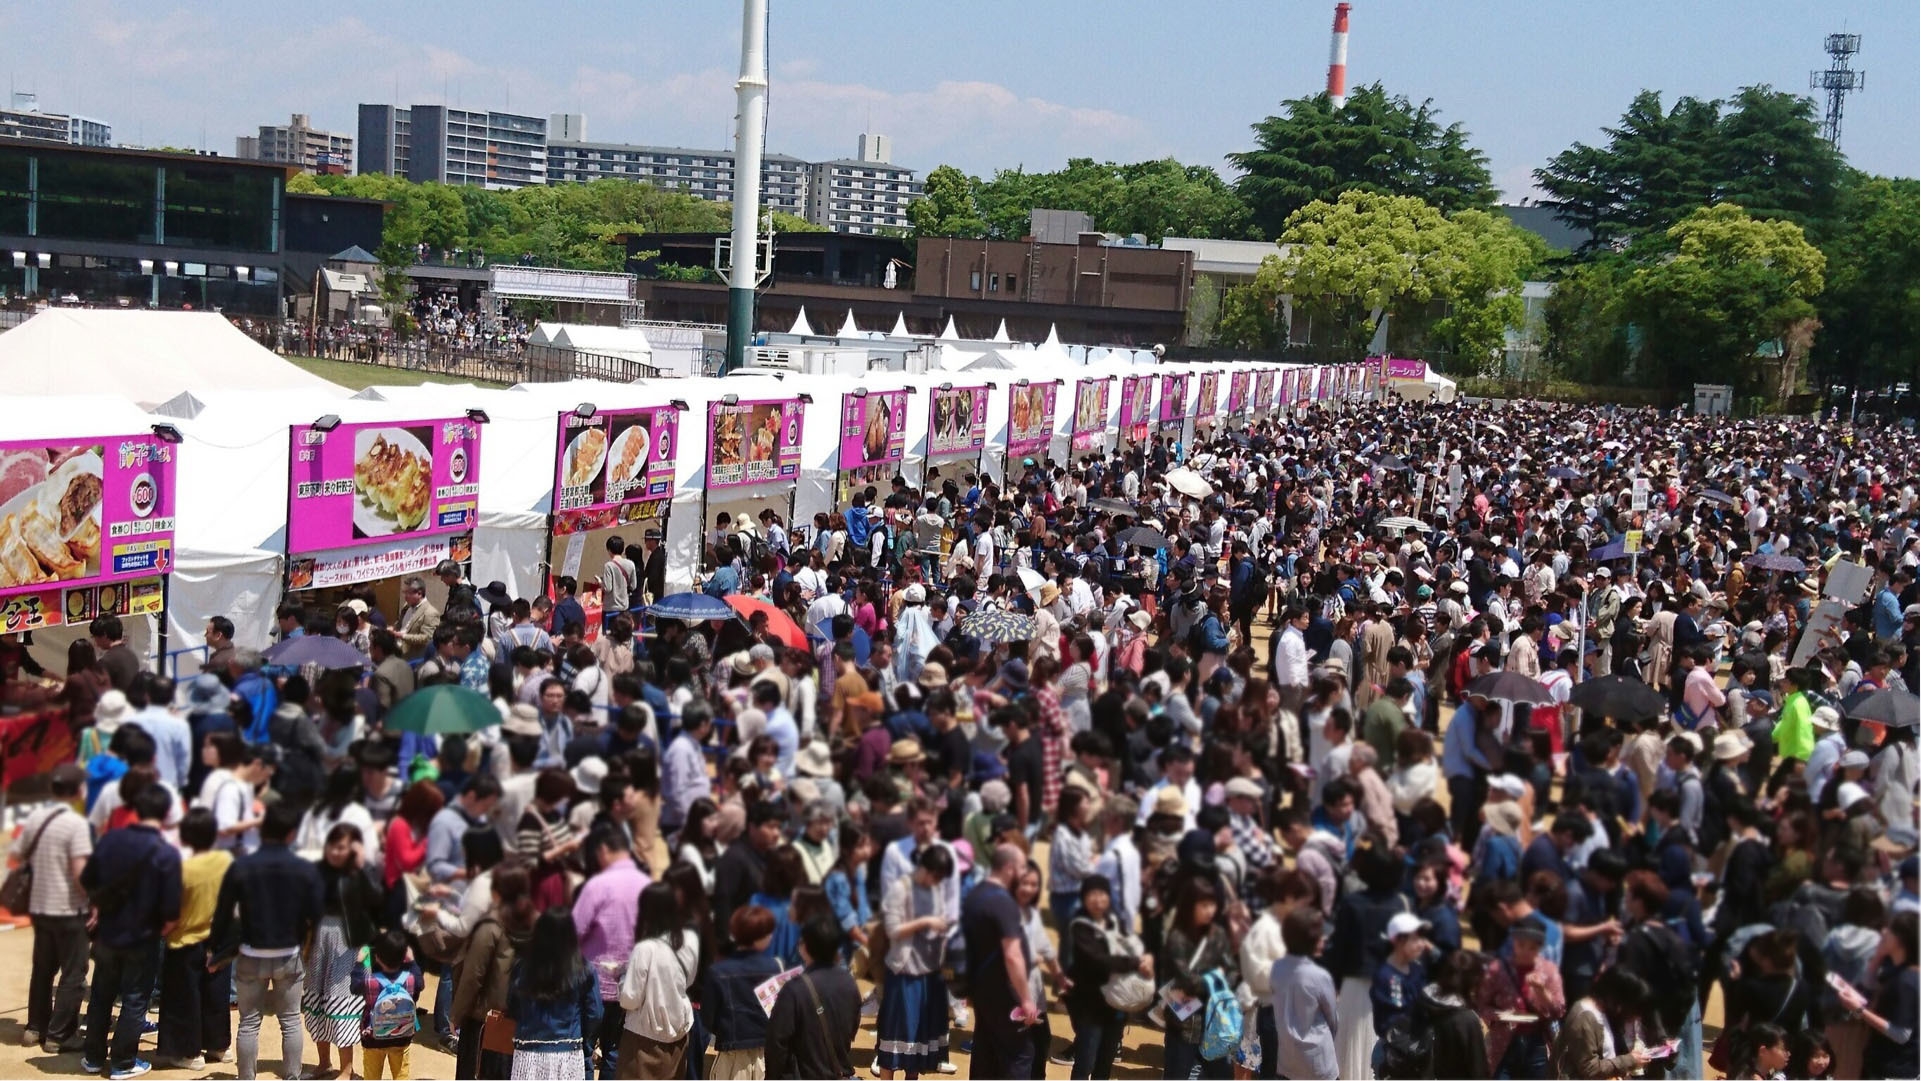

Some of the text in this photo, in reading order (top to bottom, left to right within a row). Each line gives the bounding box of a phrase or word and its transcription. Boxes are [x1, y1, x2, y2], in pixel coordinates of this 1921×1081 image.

[119, 441, 171, 469] 餃子フェス
